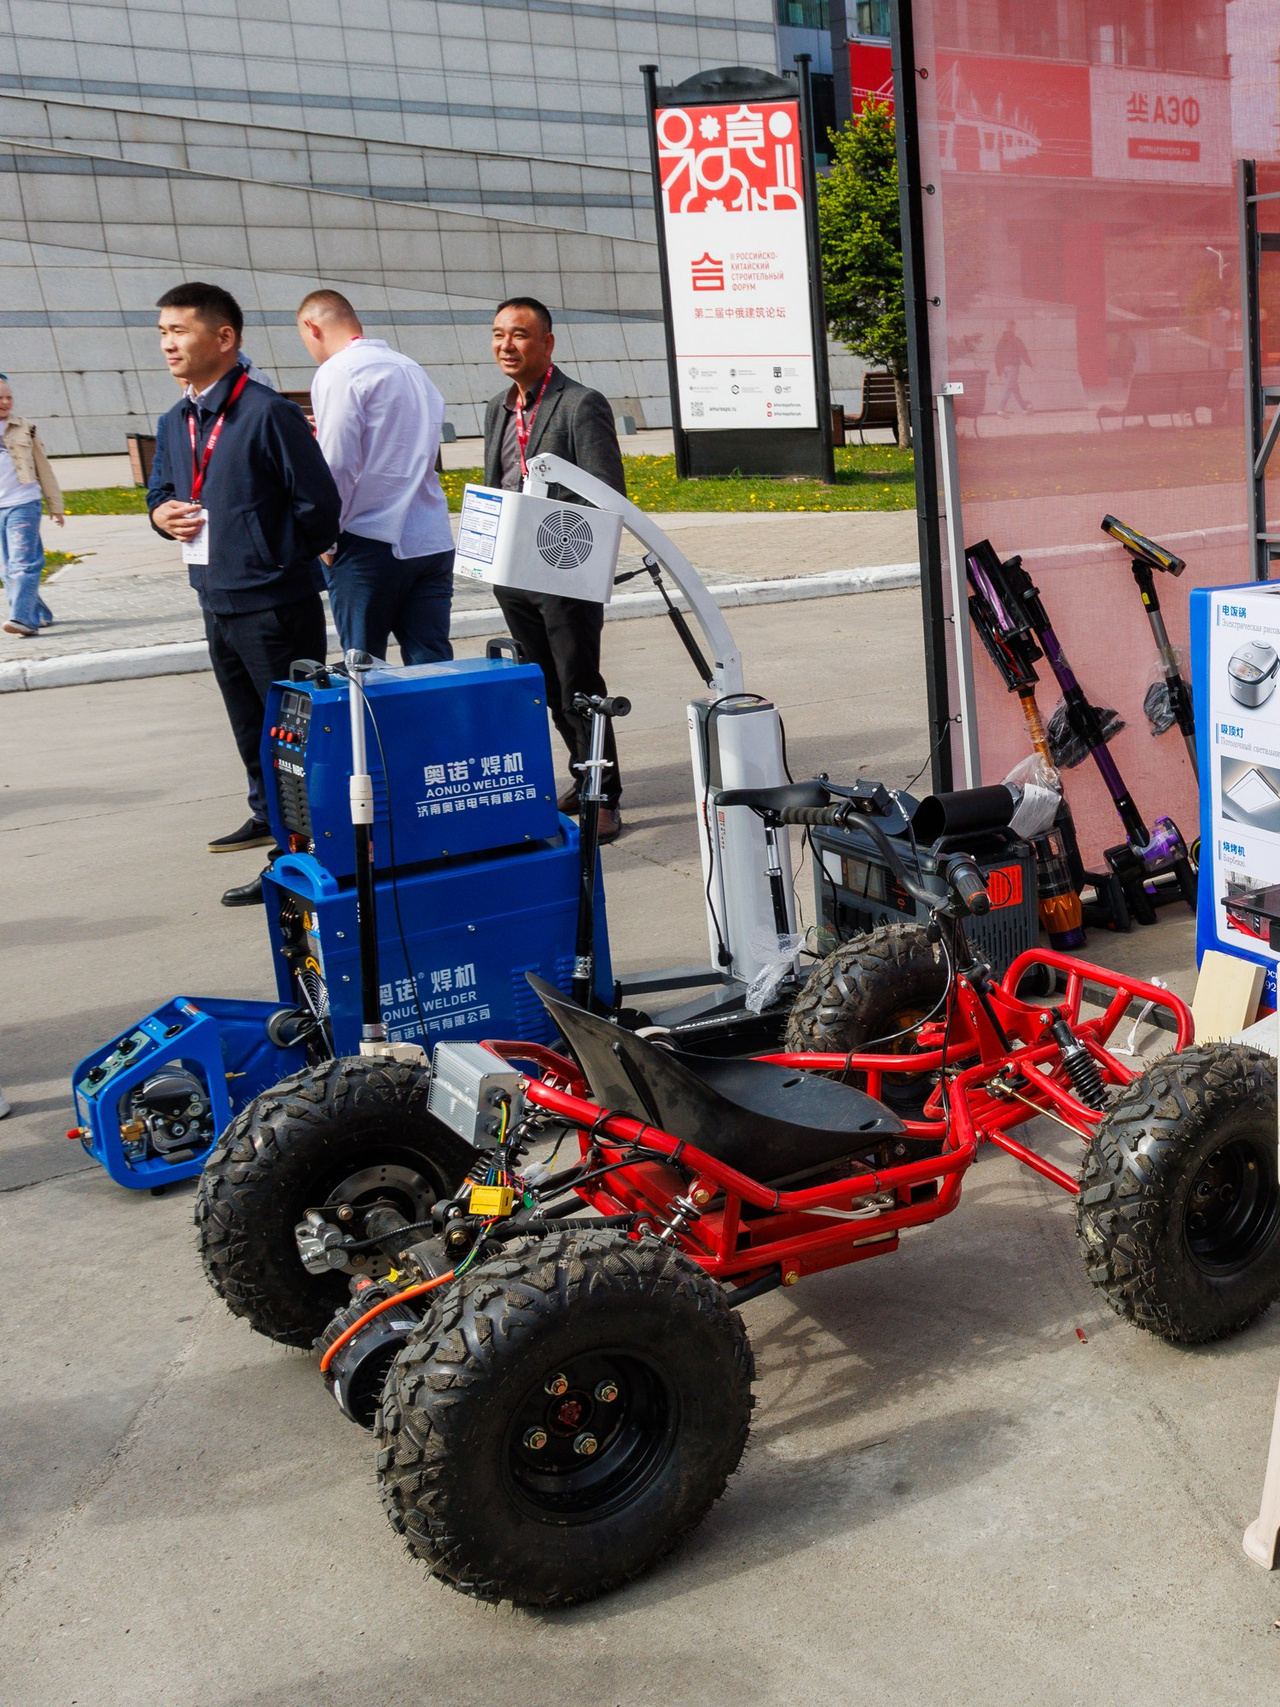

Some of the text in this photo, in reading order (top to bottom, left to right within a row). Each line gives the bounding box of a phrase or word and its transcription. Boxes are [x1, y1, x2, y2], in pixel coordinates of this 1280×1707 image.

[1153, 95, 1201, 128] АЭФ
[736, 251, 778, 261] РОССИЙСКО-
[730, 262, 769, 270] КИТАЙСКИЙ
[731, 272, 784, 281] СТРОИТЕЛЬНЫЙ
[731, 283, 756, 291] ФОРУМ
[694, 306, 786, 319] 第二届中俄建筑论坛
[1221, 604, 1246, 618] 电饭锅
[1220, 723, 1244, 738] 吸顶灯
[480, 751, 524, 777] 焊机
[426, 774, 524, 798] AONUO WELDER
[417, 787, 536, 818] 济南奥诺电气有限公司
[430, 964, 476, 994] 焊机
[382, 990, 477, 1023] ONUO WELDER
[386, 1008, 491, 1043] 奥诺电气有限公司
